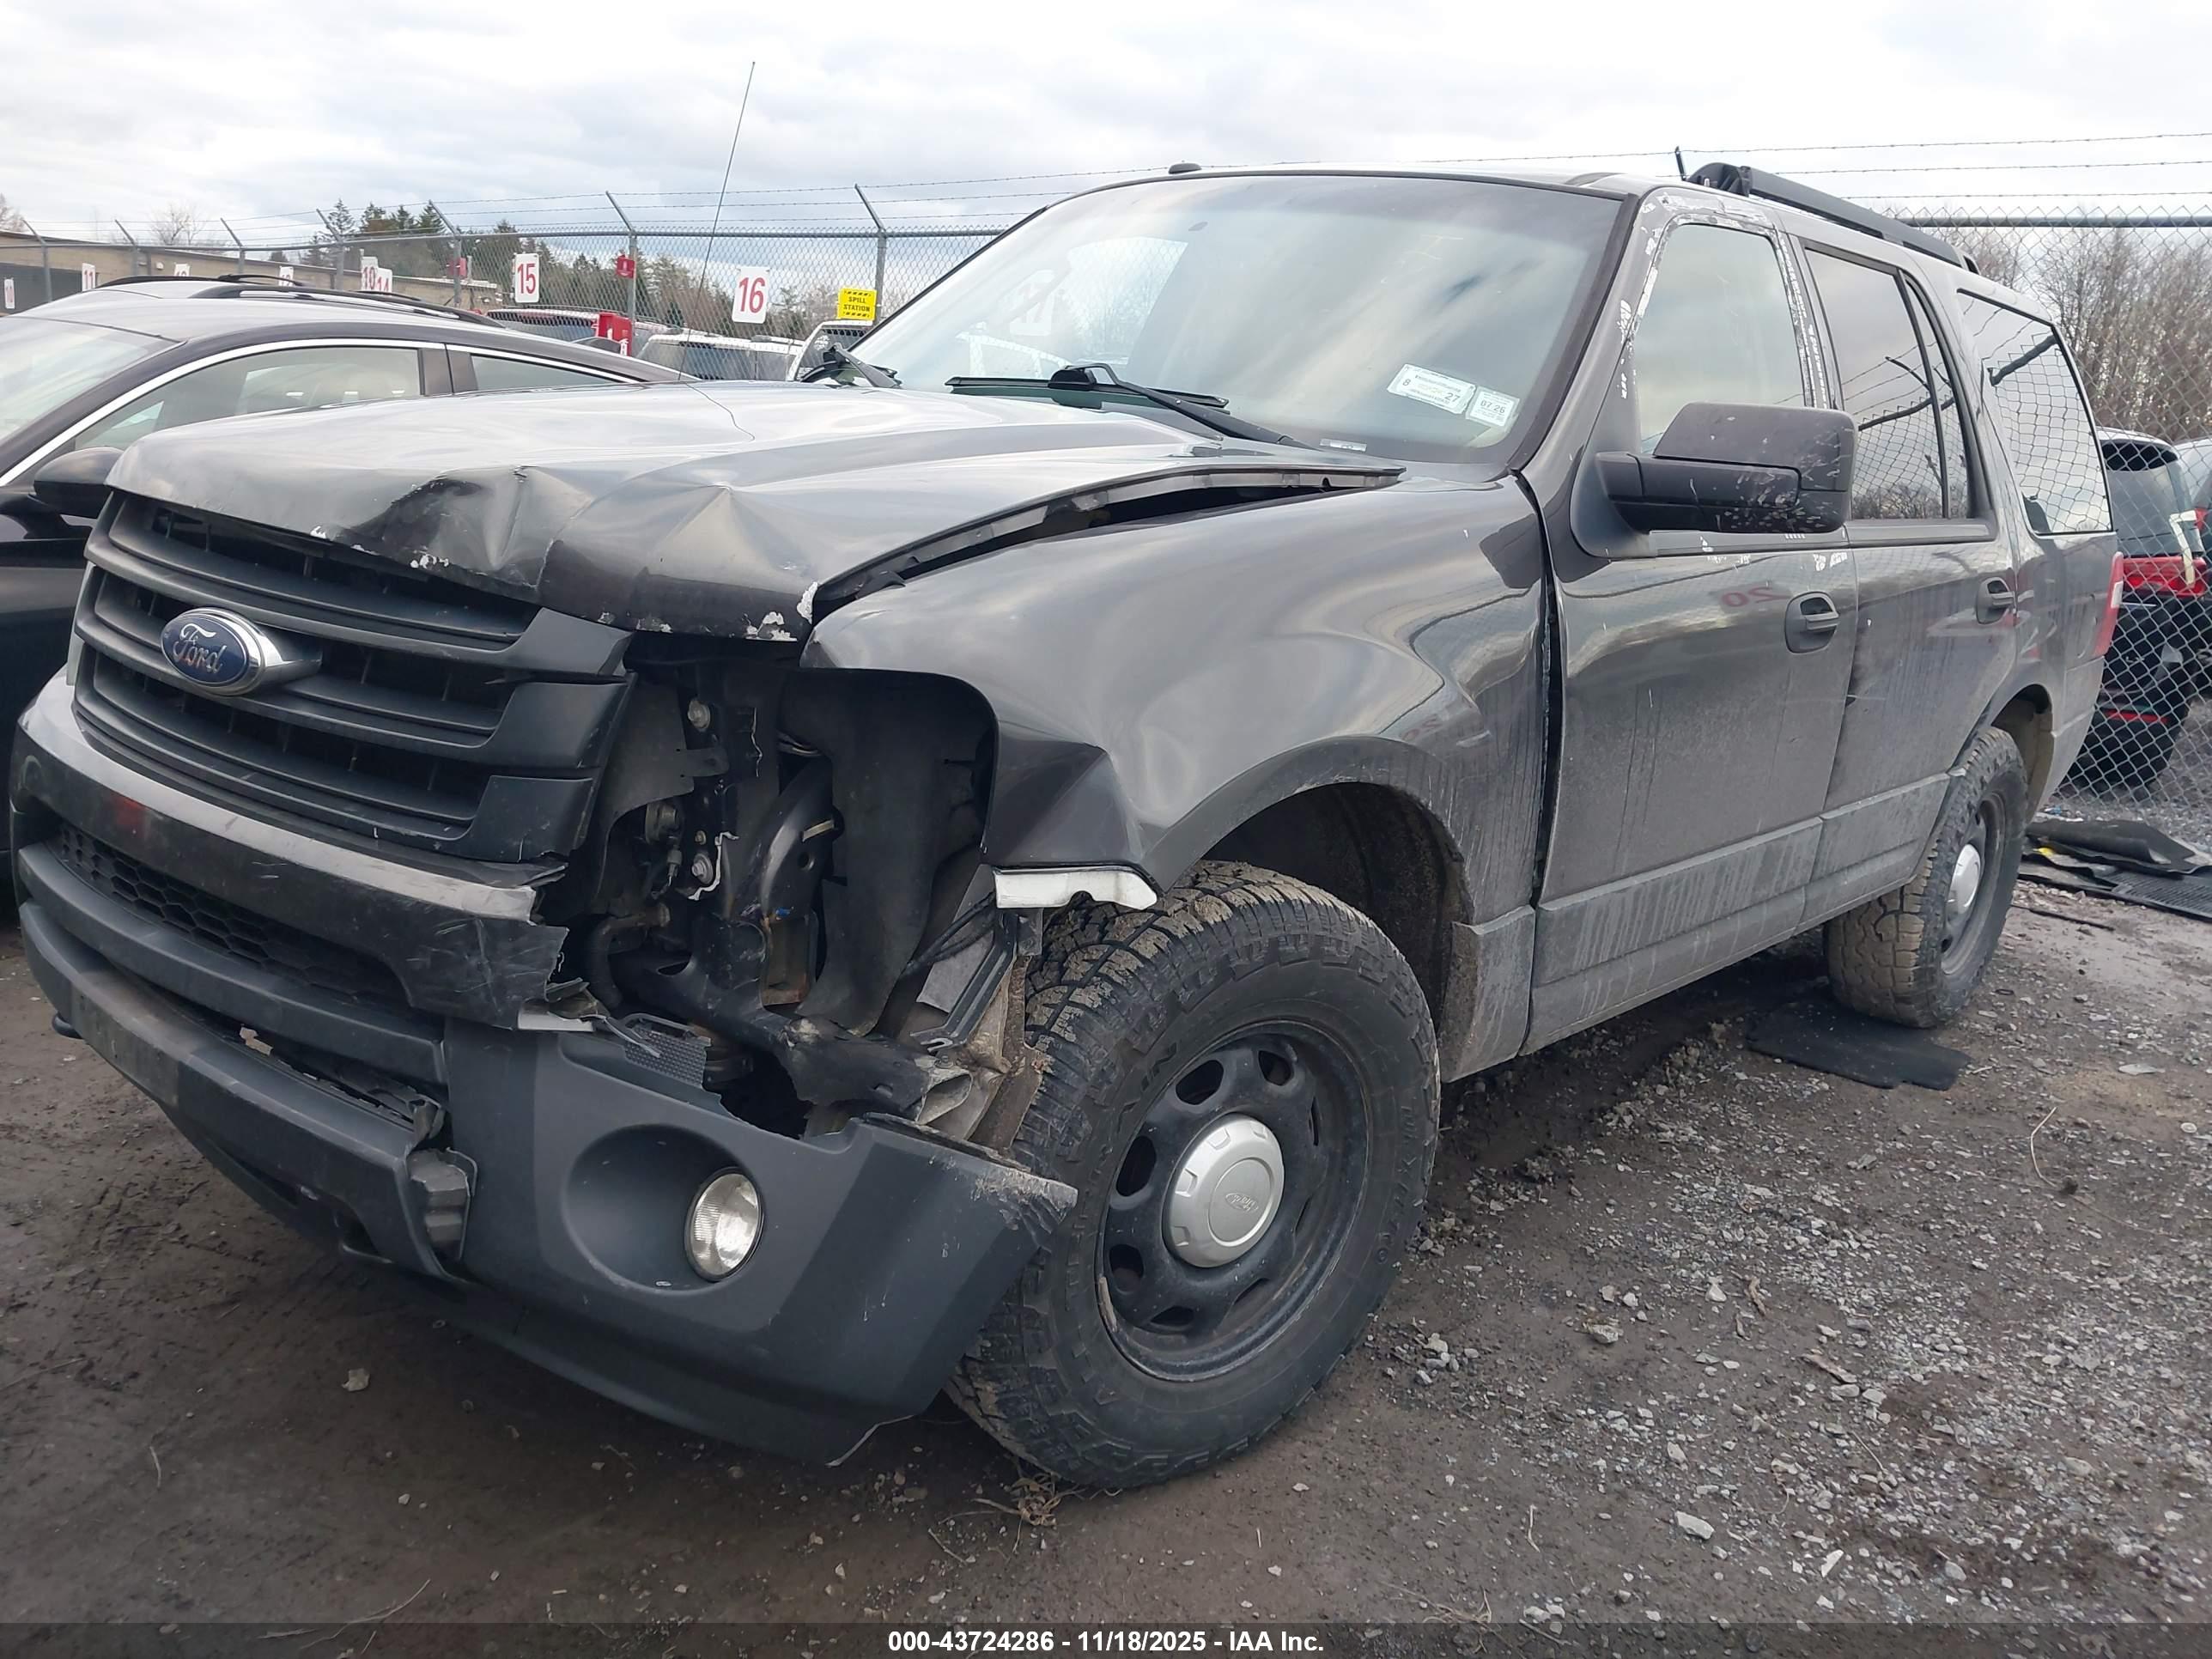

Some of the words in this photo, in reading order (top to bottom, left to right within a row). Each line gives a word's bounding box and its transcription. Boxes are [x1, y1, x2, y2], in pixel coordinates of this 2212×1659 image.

[517, 263, 537, 295] 15
[738, 276, 766, 313] 16
[1444, 392, 1461, 402] 27
[173, 623, 228, 674] Ford
